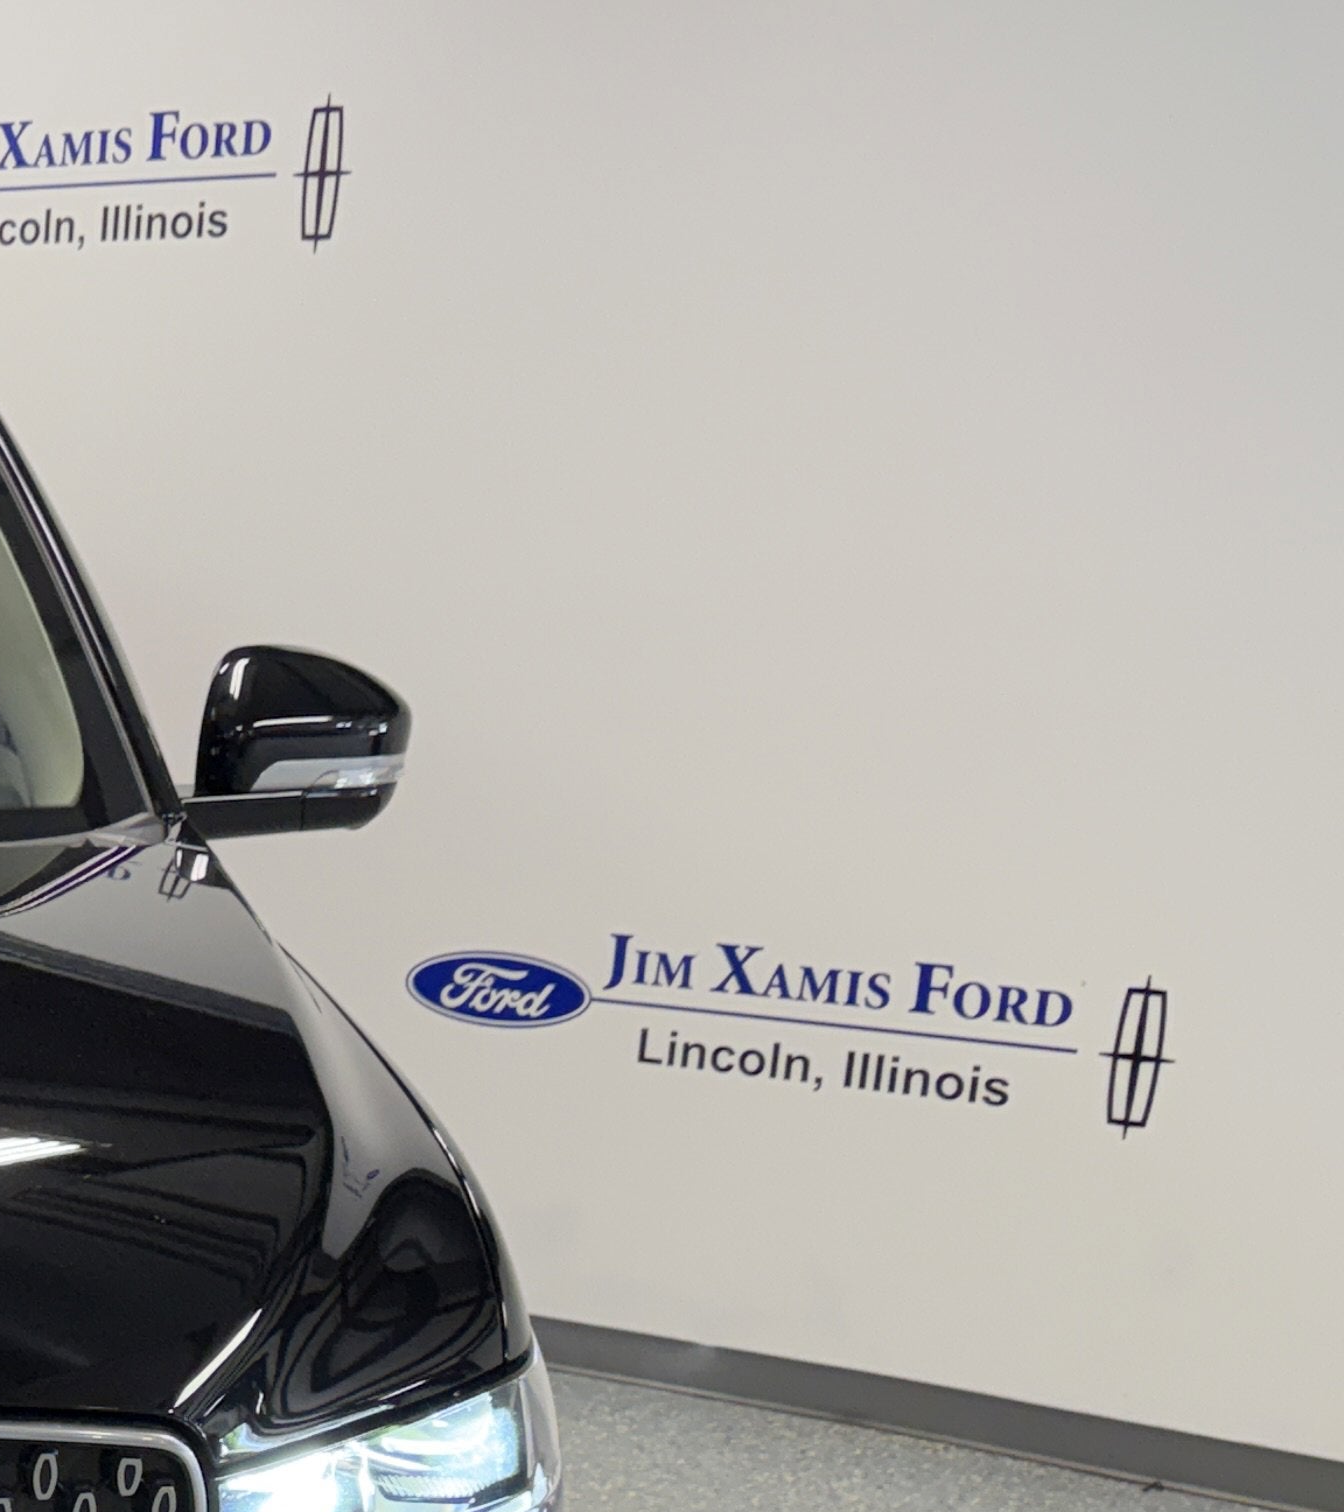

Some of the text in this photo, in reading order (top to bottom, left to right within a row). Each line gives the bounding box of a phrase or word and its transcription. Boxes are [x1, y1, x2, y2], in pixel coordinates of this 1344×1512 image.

[146, 110, 272, 162] FORD
[100, 202, 229, 243] Illinois
[438, 962, 552, 1021] Ford
[603, 933, 1074, 1028] JIM XAMIS FORD
[637, 1027, 1010, 1107] Lincoln, Illinois
